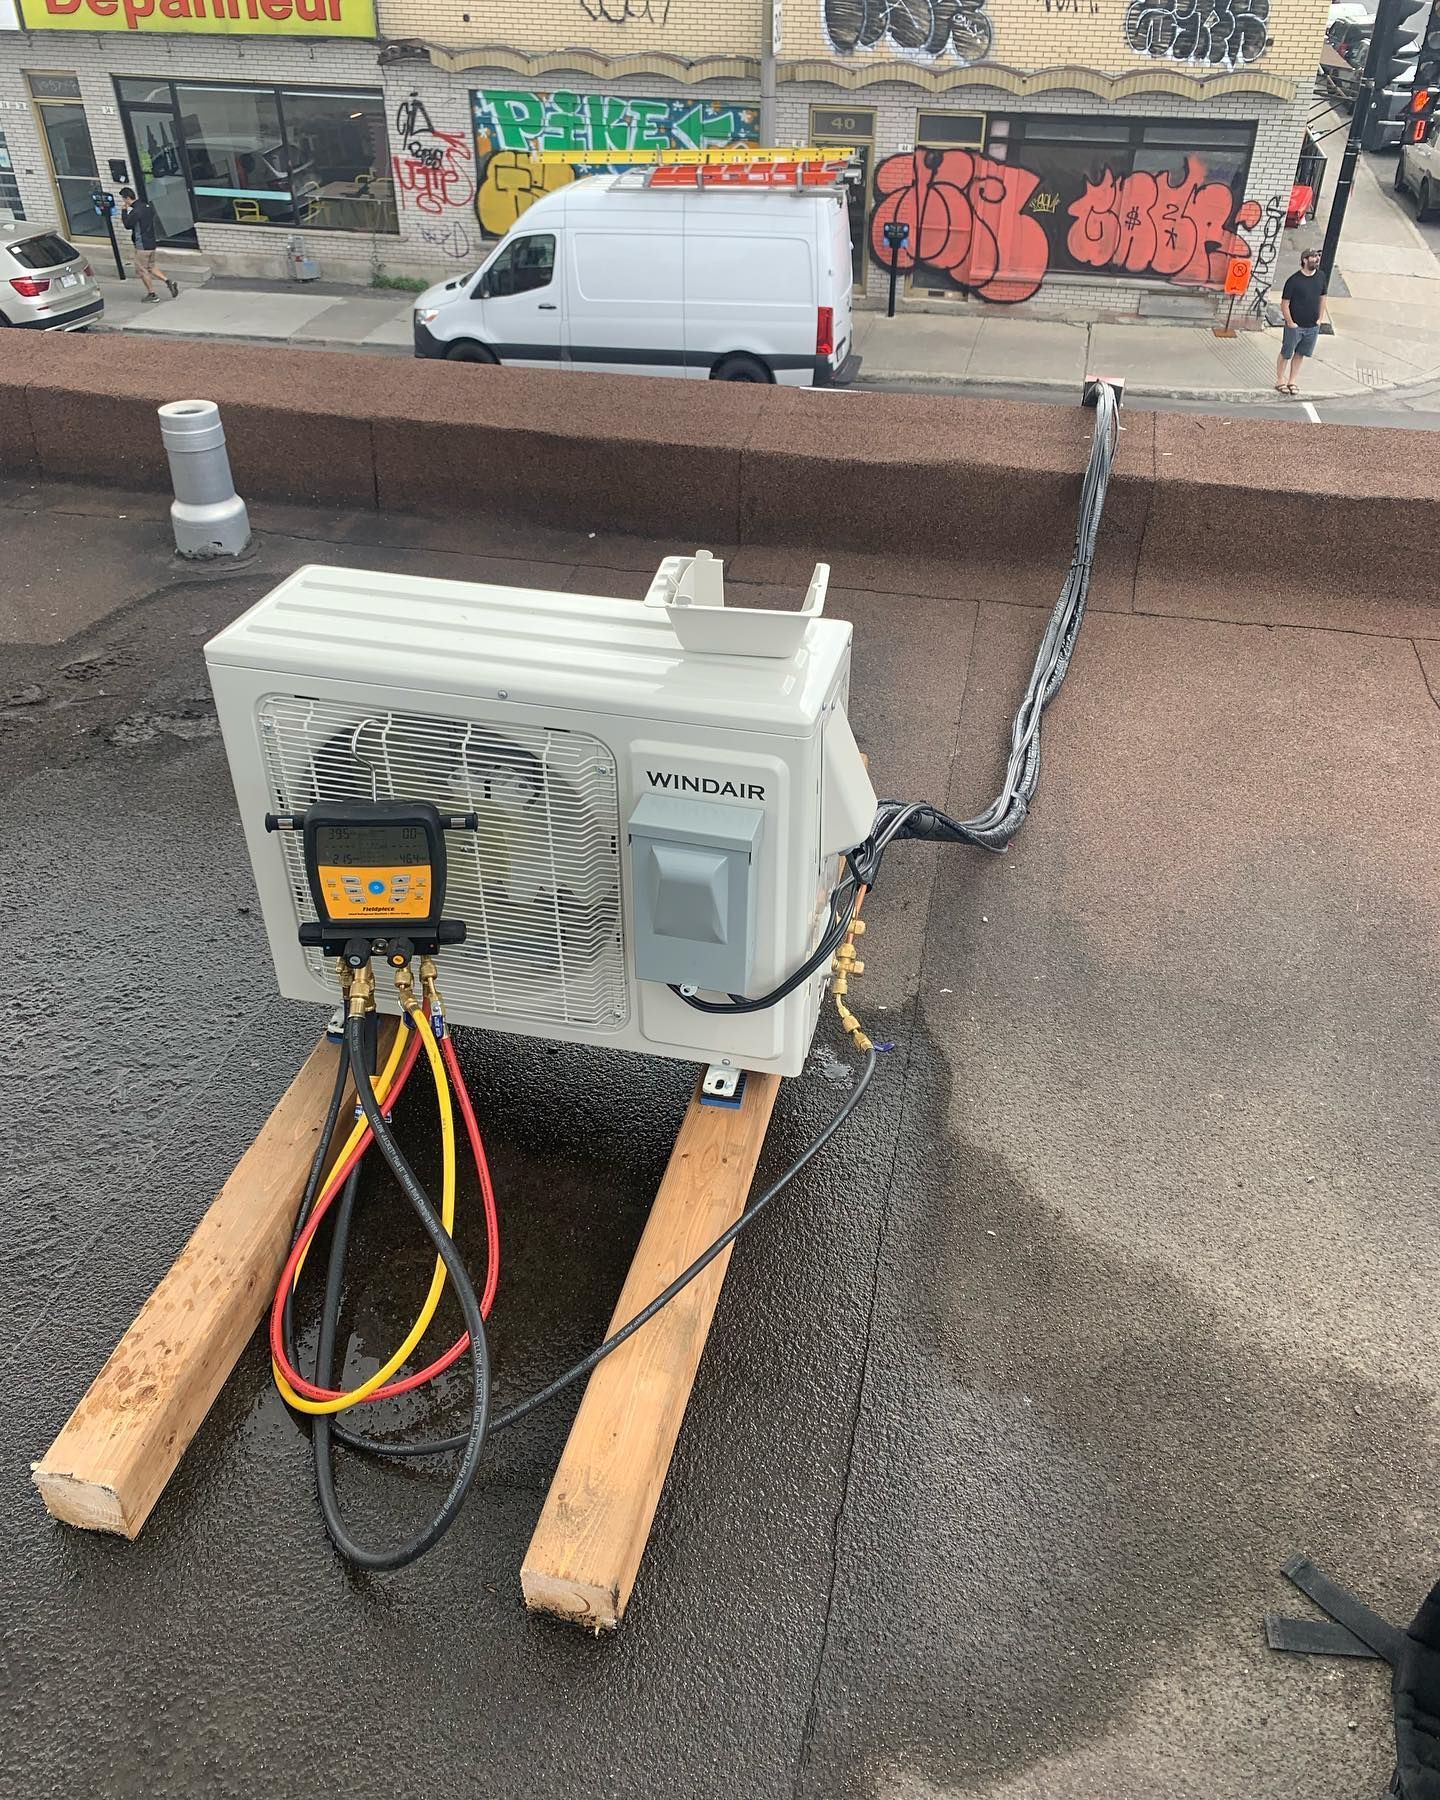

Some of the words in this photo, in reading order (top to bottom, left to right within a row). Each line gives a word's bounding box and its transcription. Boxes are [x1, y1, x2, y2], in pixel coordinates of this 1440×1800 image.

[832, 117, 856, 130] 40
[646, 770, 766, 801] WINDAIR
[371, 1113, 385, 1134] YELLOW
[472, 1335, 483, 1365] YELLOW
[465, 1437, 477, 1460] Heavy
[444, 1479, 463, 1510] Charging
